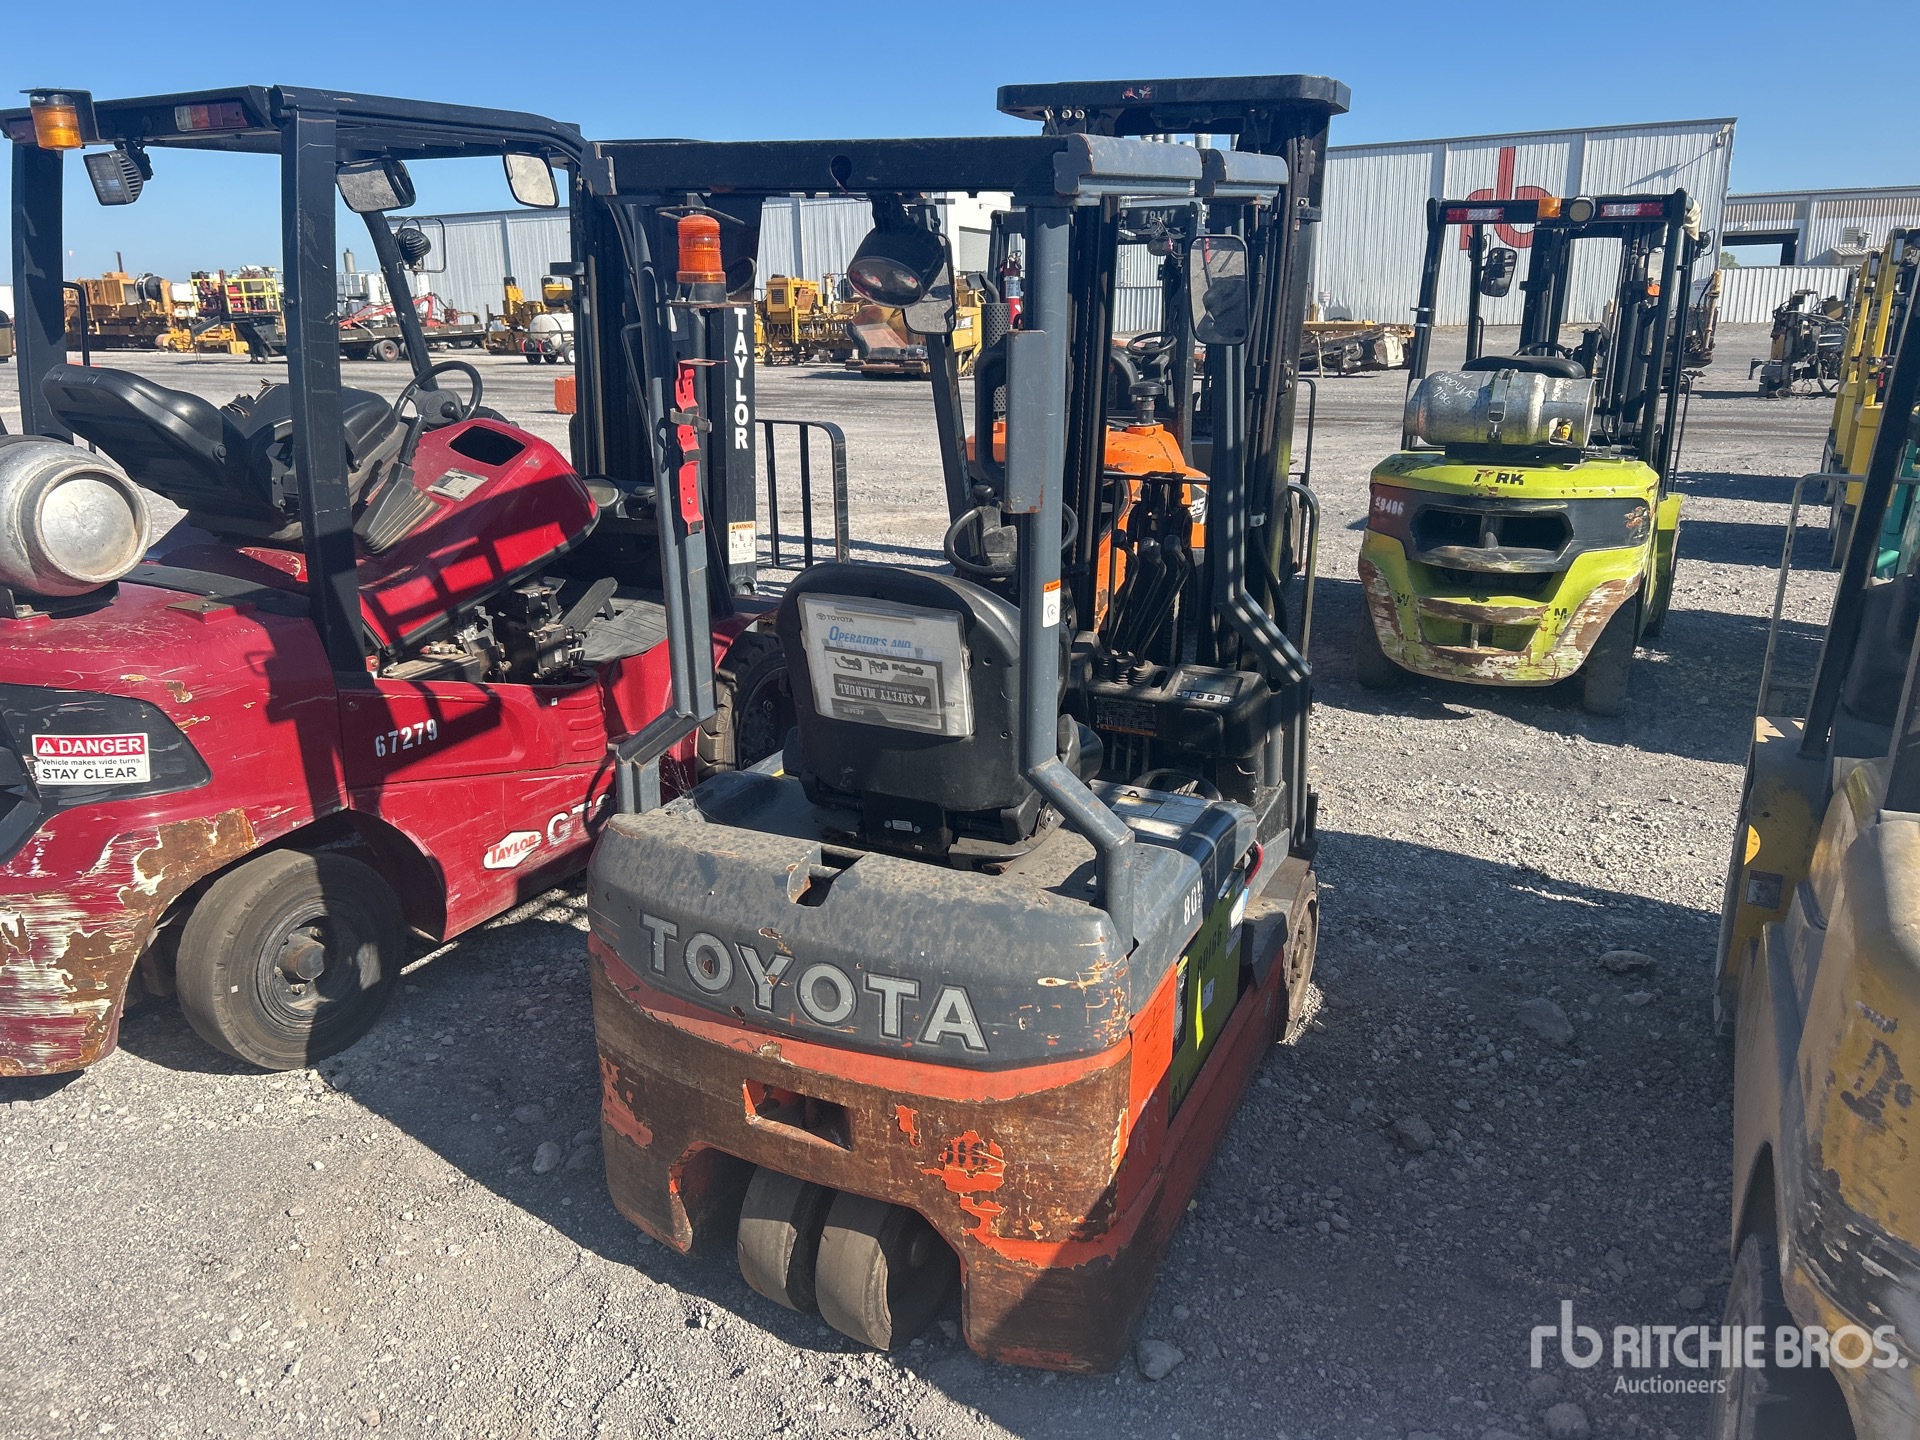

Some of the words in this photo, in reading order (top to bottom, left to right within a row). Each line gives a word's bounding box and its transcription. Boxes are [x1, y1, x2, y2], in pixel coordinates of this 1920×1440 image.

[734, 307, 749, 449] TAYLOR
[827, 614, 854, 623] TOYOTA
[838, 683, 876, 699] MANUAL
[880, 689, 914, 704] SAFETY
[375, 718, 438, 757] 67279
[59, 738, 142, 754] DANGER
[42, 768, 79, 779] STAY
[83, 767, 137, 779] CLEAR
[488, 834, 537, 864] TAYLOR
[640, 909, 989, 1053] TOYOTA
